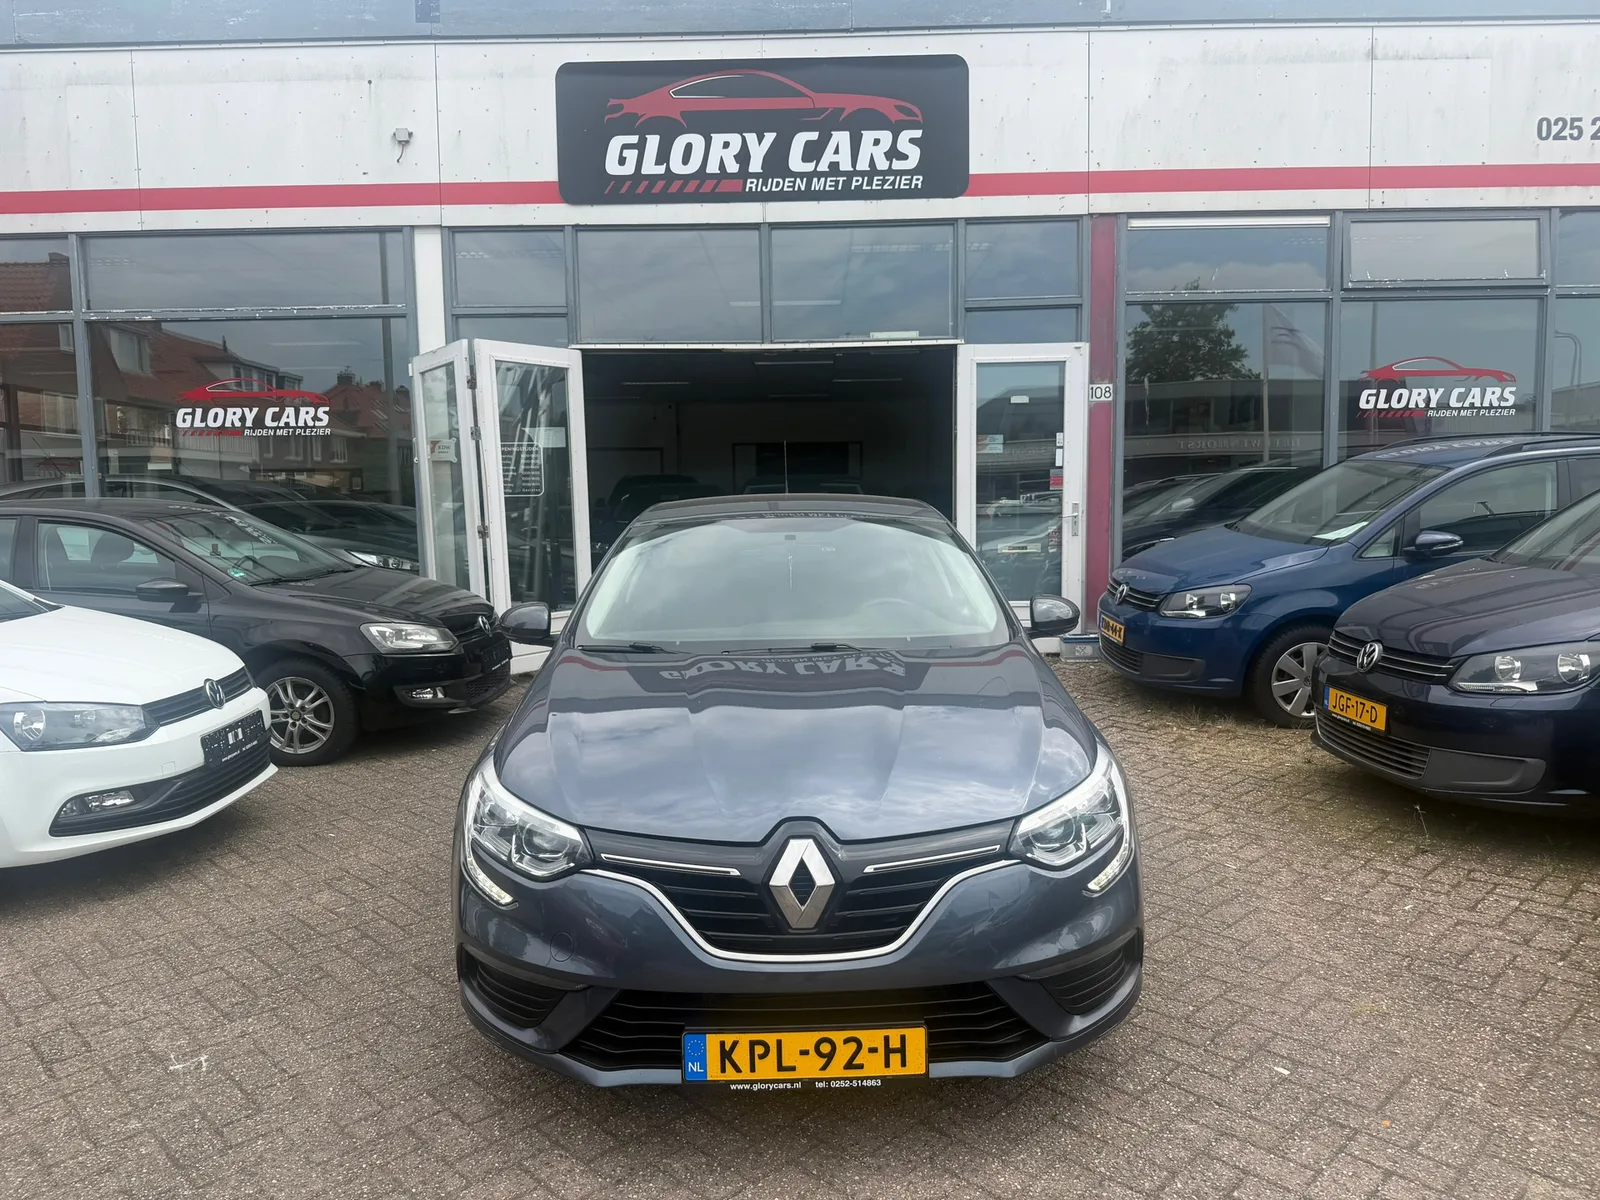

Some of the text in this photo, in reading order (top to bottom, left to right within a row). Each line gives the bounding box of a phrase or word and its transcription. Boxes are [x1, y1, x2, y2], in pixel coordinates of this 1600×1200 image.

[1536, 116, 1584, 141] 025
[605, 129, 923, 175] GLORY CARS
[745, 175, 924, 192] RIJDEN MET PLEZIER
[1090, 386, 1112, 399] 108
[1358, 386, 1517, 410] GLORY CARS
[175, 406, 330, 428] GLORY CARS
[1459, 409, 1478, 417] MET
[1479, 408, 1516, 416] PLEZIER
[243, 428, 331, 437] RIJDEN MET PLEZIER
[1332, 693, 1378, 723] JGF-17-D
[718, 1033, 907, 1074] KPL-92-H
[687, 1062, 704, 1072] NL
[730, 1081, 802, 1091] www.glorycars.nl
[830, 1079, 882, 1088] 0252-514863
